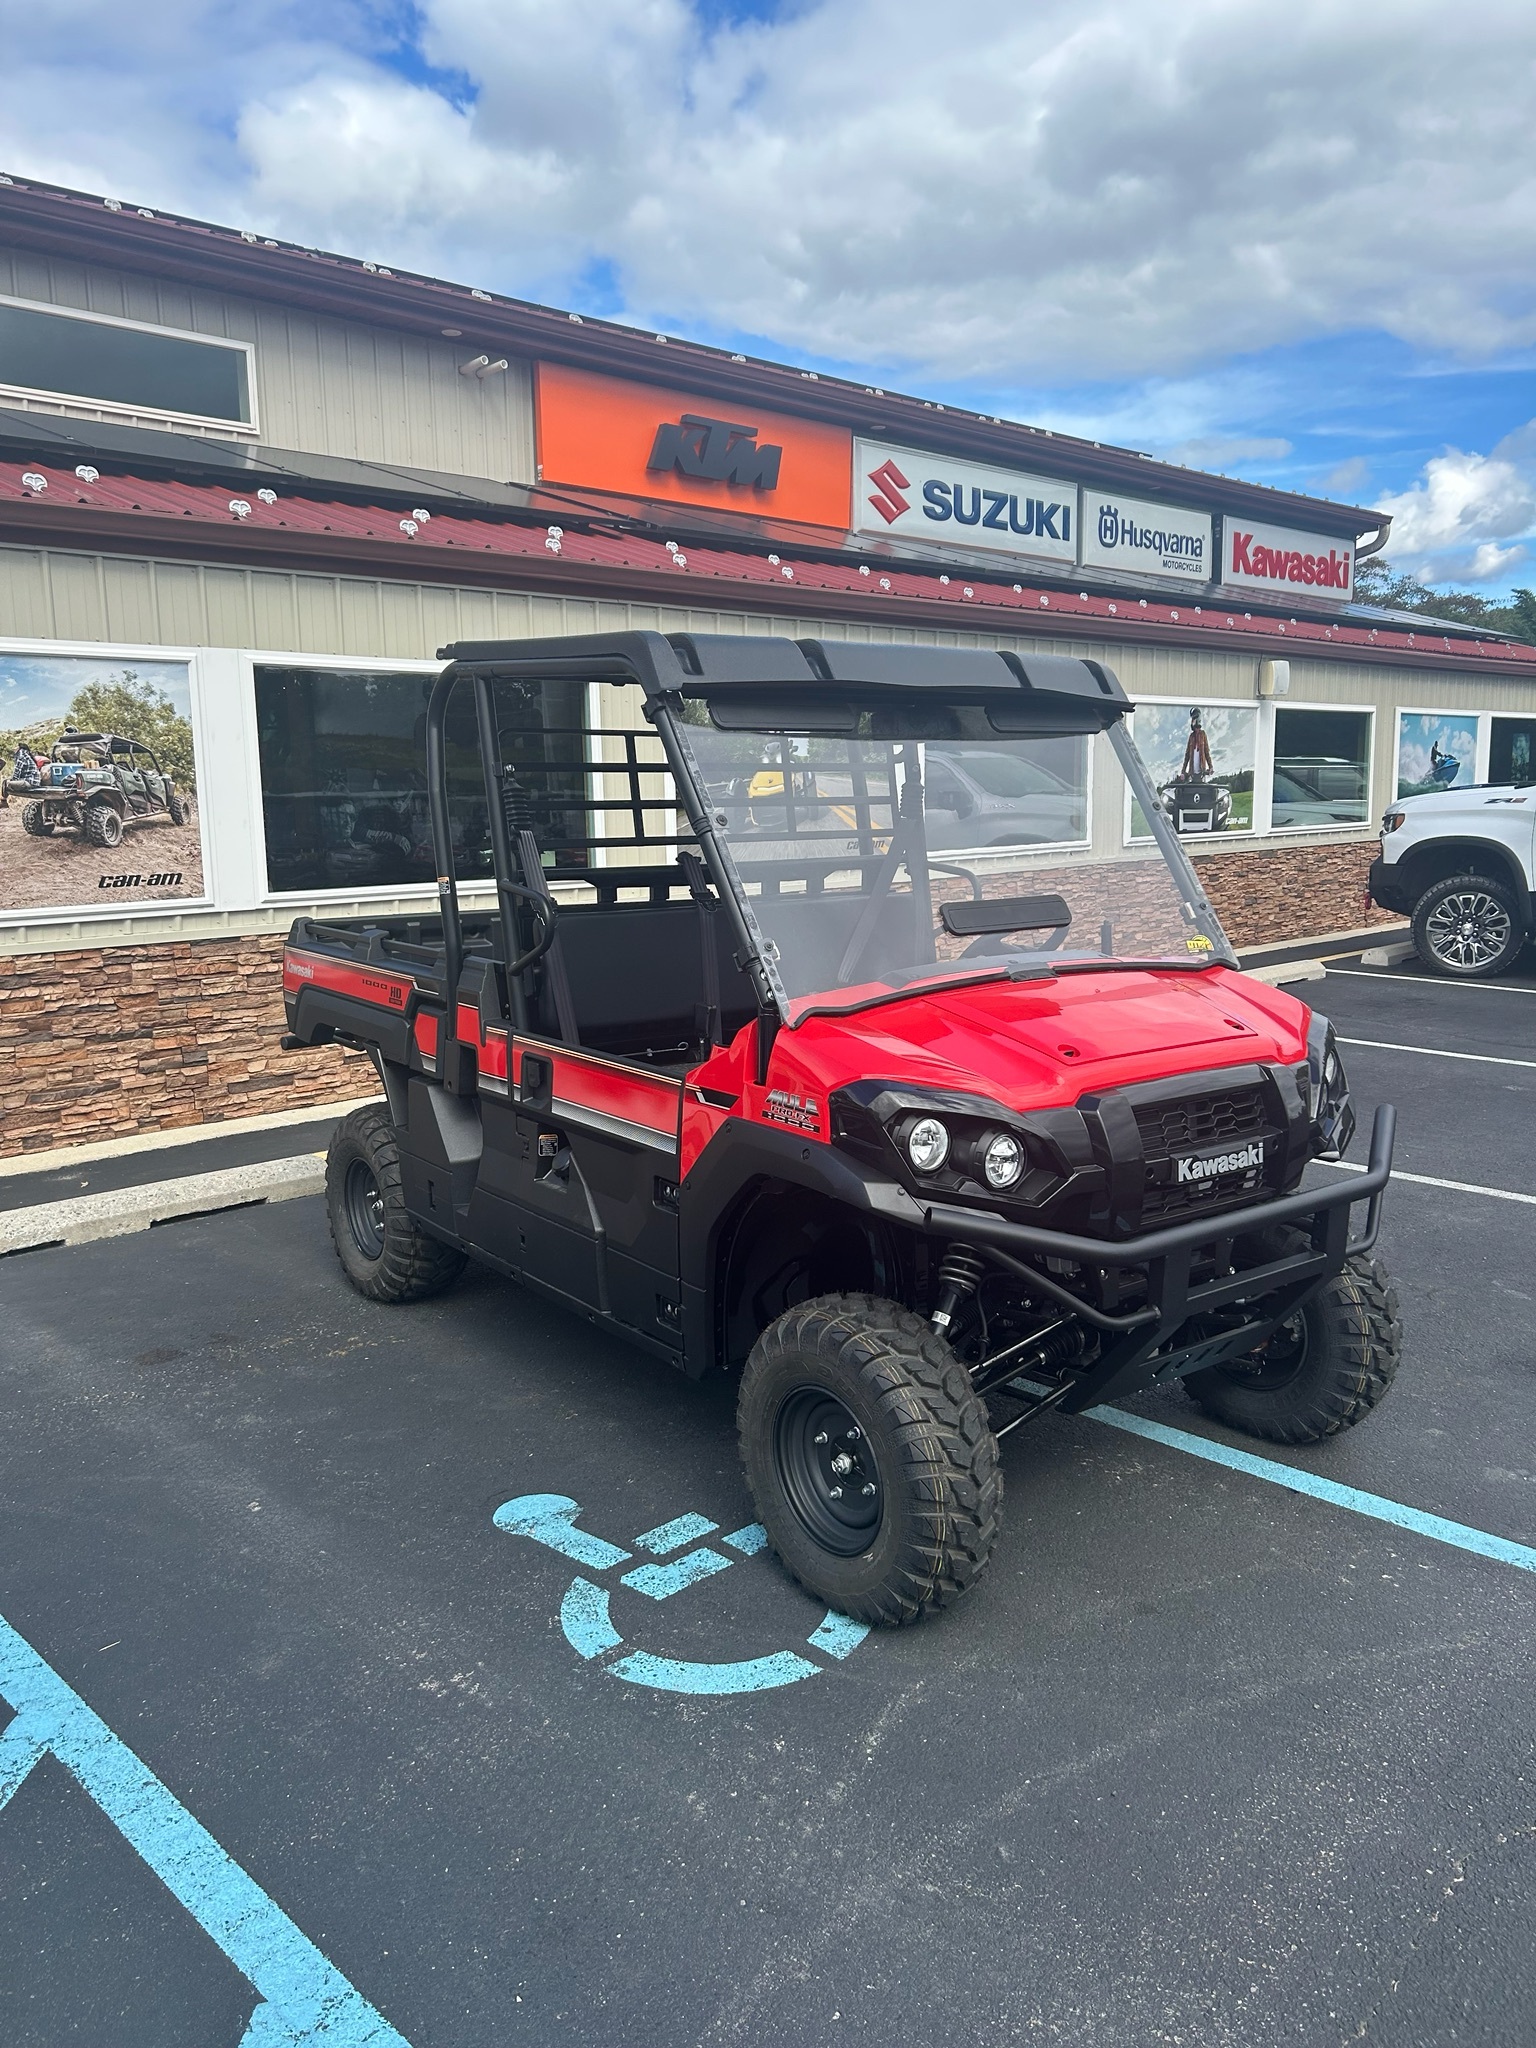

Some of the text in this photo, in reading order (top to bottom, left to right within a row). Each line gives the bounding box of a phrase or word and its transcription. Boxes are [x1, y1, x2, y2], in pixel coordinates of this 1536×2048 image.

[647, 414, 782, 490] KTM
[922, 479, 1070, 541] SUZUKI
[1121, 518, 1204, 557] Husqvarna
[1162, 559, 1202, 573] MOTORCYCLES
[1232, 531, 1350, 589] Kawasaki
[98, 872, 183, 888] can-am
[286, 959, 315, 979] Kawasaki
[390, 986, 402, 999] HD
[765, 1089, 820, 1117] MULE
[1178, 1142, 1264, 1182] Kawasaki
